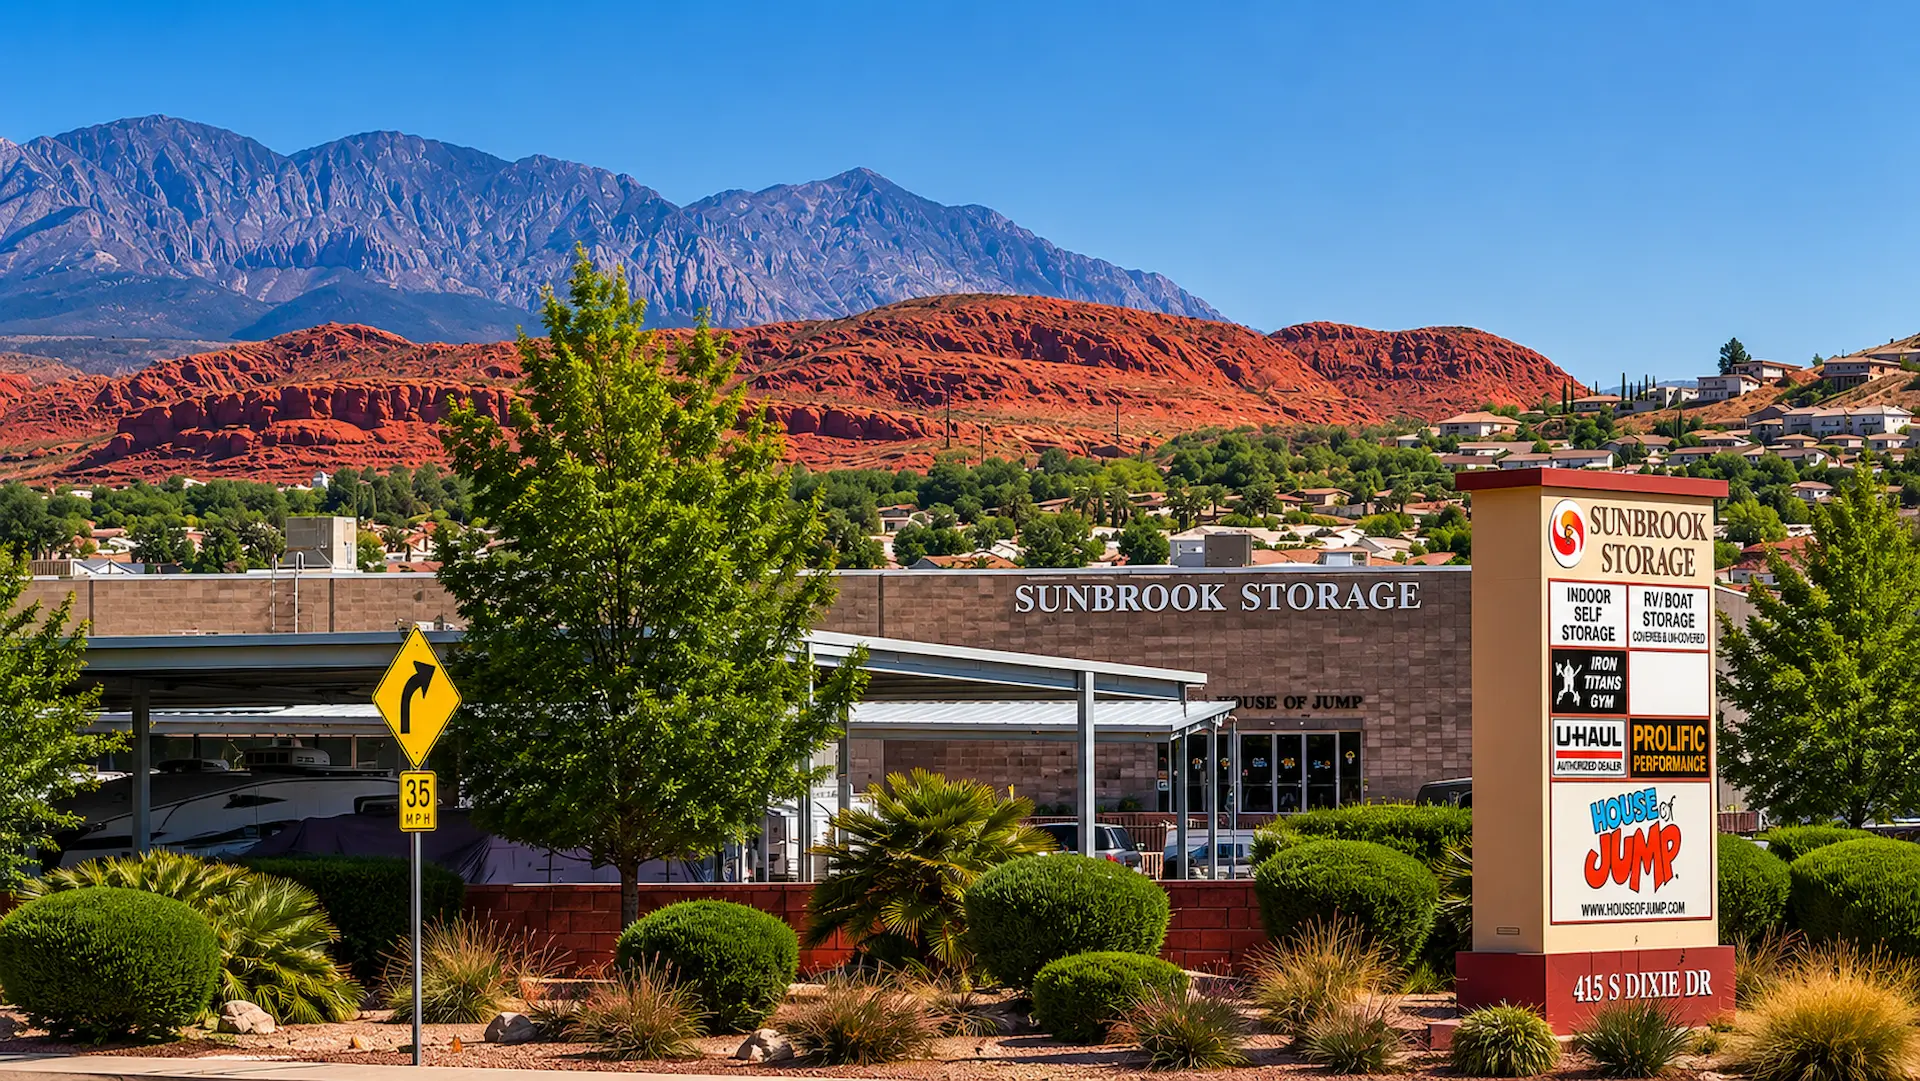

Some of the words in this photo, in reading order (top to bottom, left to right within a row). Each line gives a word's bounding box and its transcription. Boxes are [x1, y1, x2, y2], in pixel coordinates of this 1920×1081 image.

[1590, 505, 1708, 541] SUNBROOK
[1601, 543, 1696, 577] STORAGE
[1015, 583, 1227, 612] SUNBROOK
[1240, 581, 1421, 611] STORAGE
[1567, 587, 1611, 604] INDOOR
[1644, 591, 1694, 609] RV/BOAT
[1574, 607, 1602, 622] SELF
[1643, 611, 1695, 628] STORAGE
[1562, 625, 1615, 642] STORAGE
[1591, 656, 1618, 671] IRON
[1584, 675, 1622, 691] TITANS
[1283, 695, 1307, 709] OF
[1312, 695, 1363, 709] JUMP
[1590, 694, 1614, 709] GYM
[1556, 726, 1622, 747] U-HAUL
[1633, 724, 1706, 752] PROLIFIC
[1557, 760, 1597, 771] AUTHORIZED
[1598, 761, 1622, 771] DEALER
[1633, 755, 1707, 772] PERFORMANCE
[406, 779, 430, 807] 35
[406, 813, 430, 825] MPH
[1590, 787, 1659, 834] HOUSE
[1581, 901, 1685, 917] WWW.HOUSEOFJUMP.COM
[1573, 974, 1603, 1001] 415
[1608, 973, 1620, 999] S
[1625, 971, 1681, 998] DIXIE
[1685, 969, 1713, 996] DR
